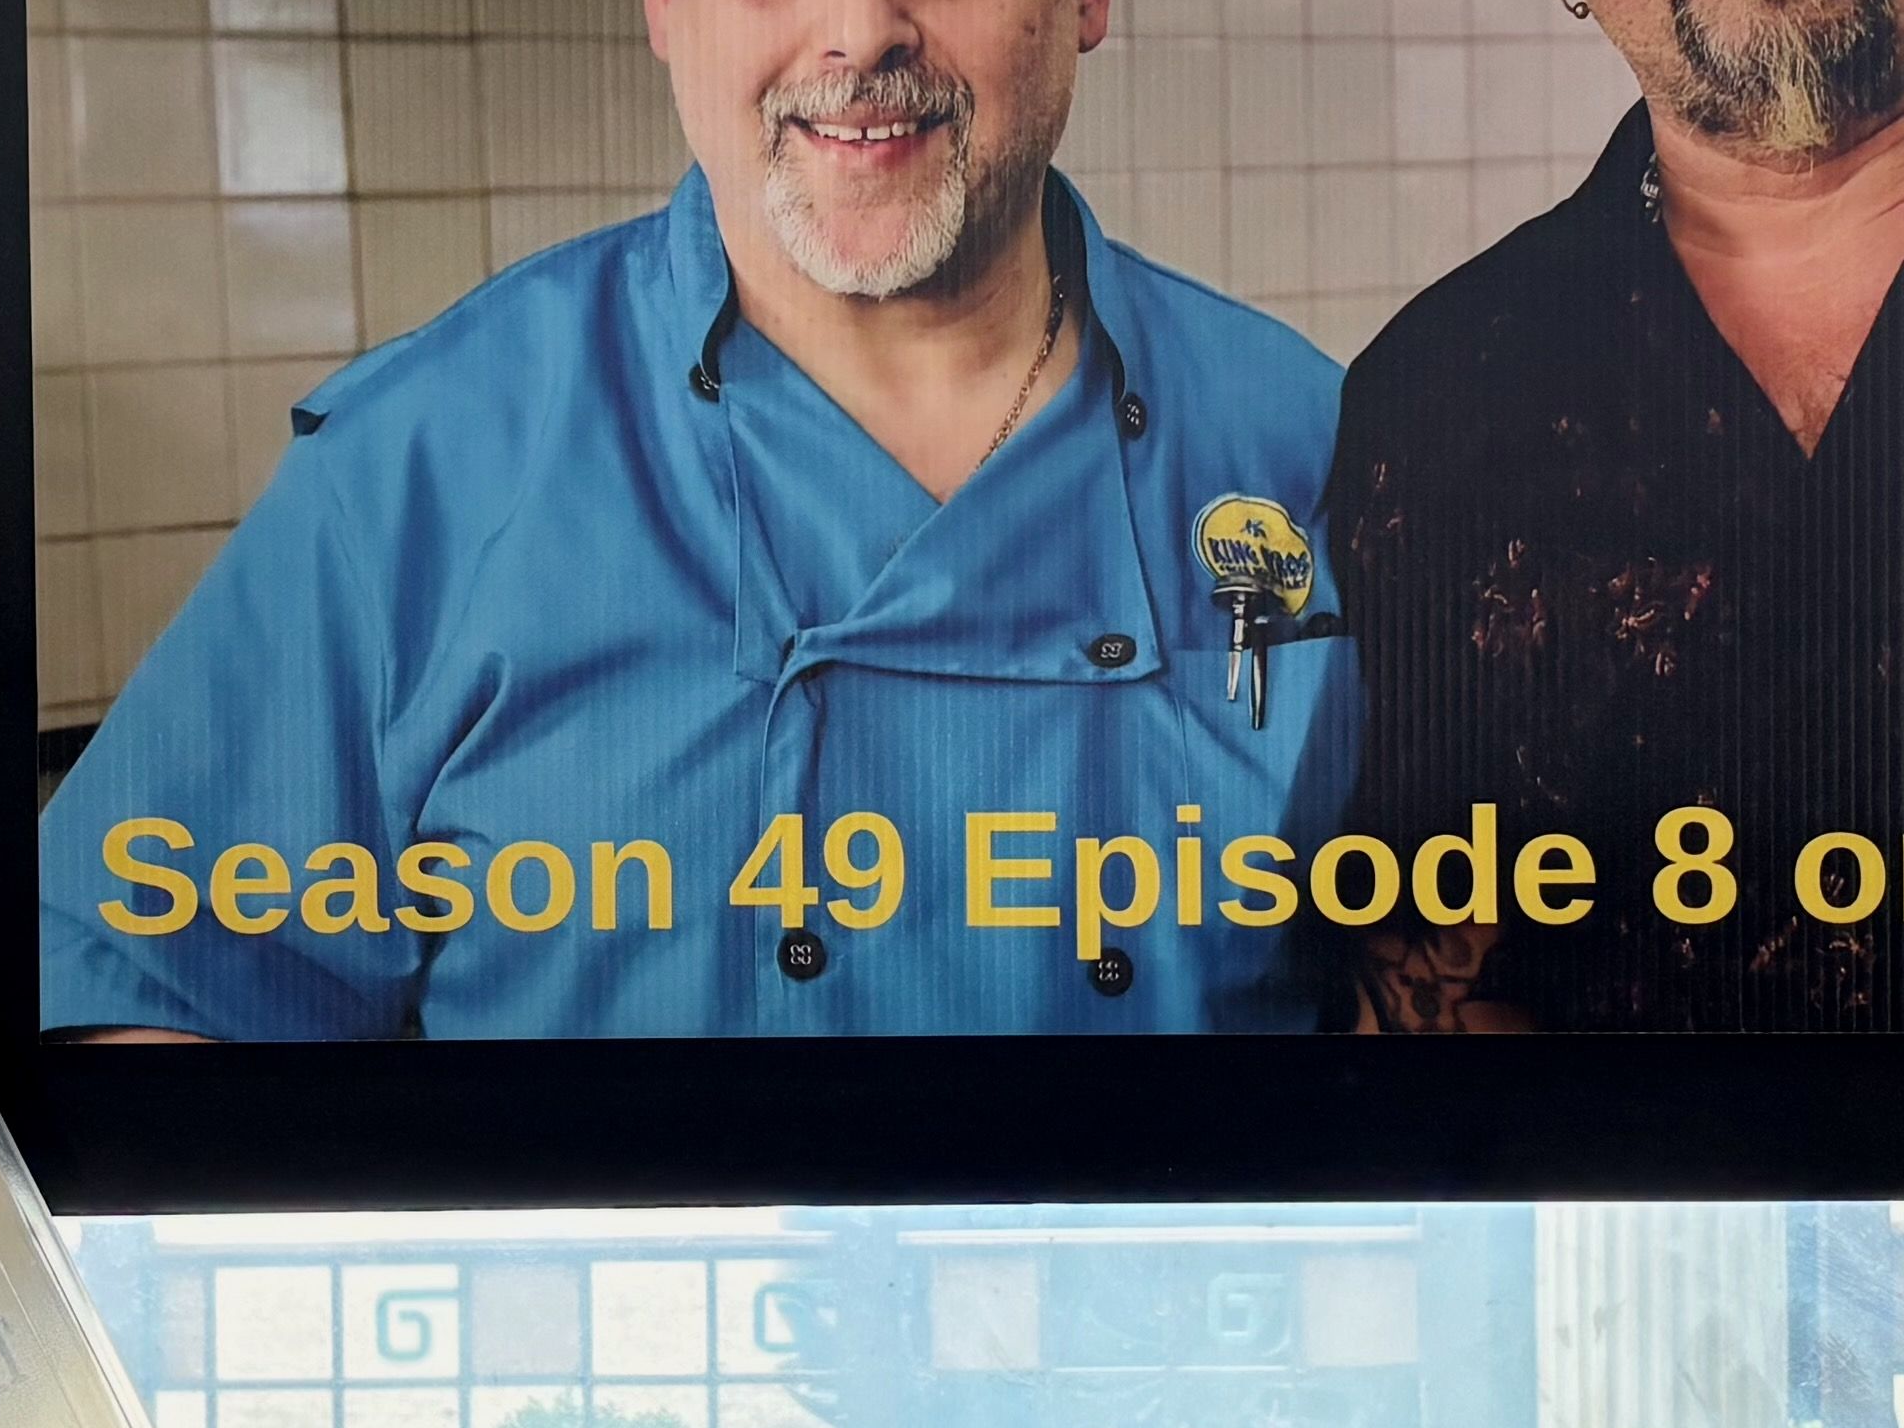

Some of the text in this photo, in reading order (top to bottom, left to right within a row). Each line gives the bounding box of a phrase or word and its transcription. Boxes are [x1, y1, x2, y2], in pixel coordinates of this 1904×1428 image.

[97, 815, 674, 936] Season
[728, 812, 906, 932] 49
[964, 802, 1597, 961] Episode
[1652, 806, 1739, 925] 8
